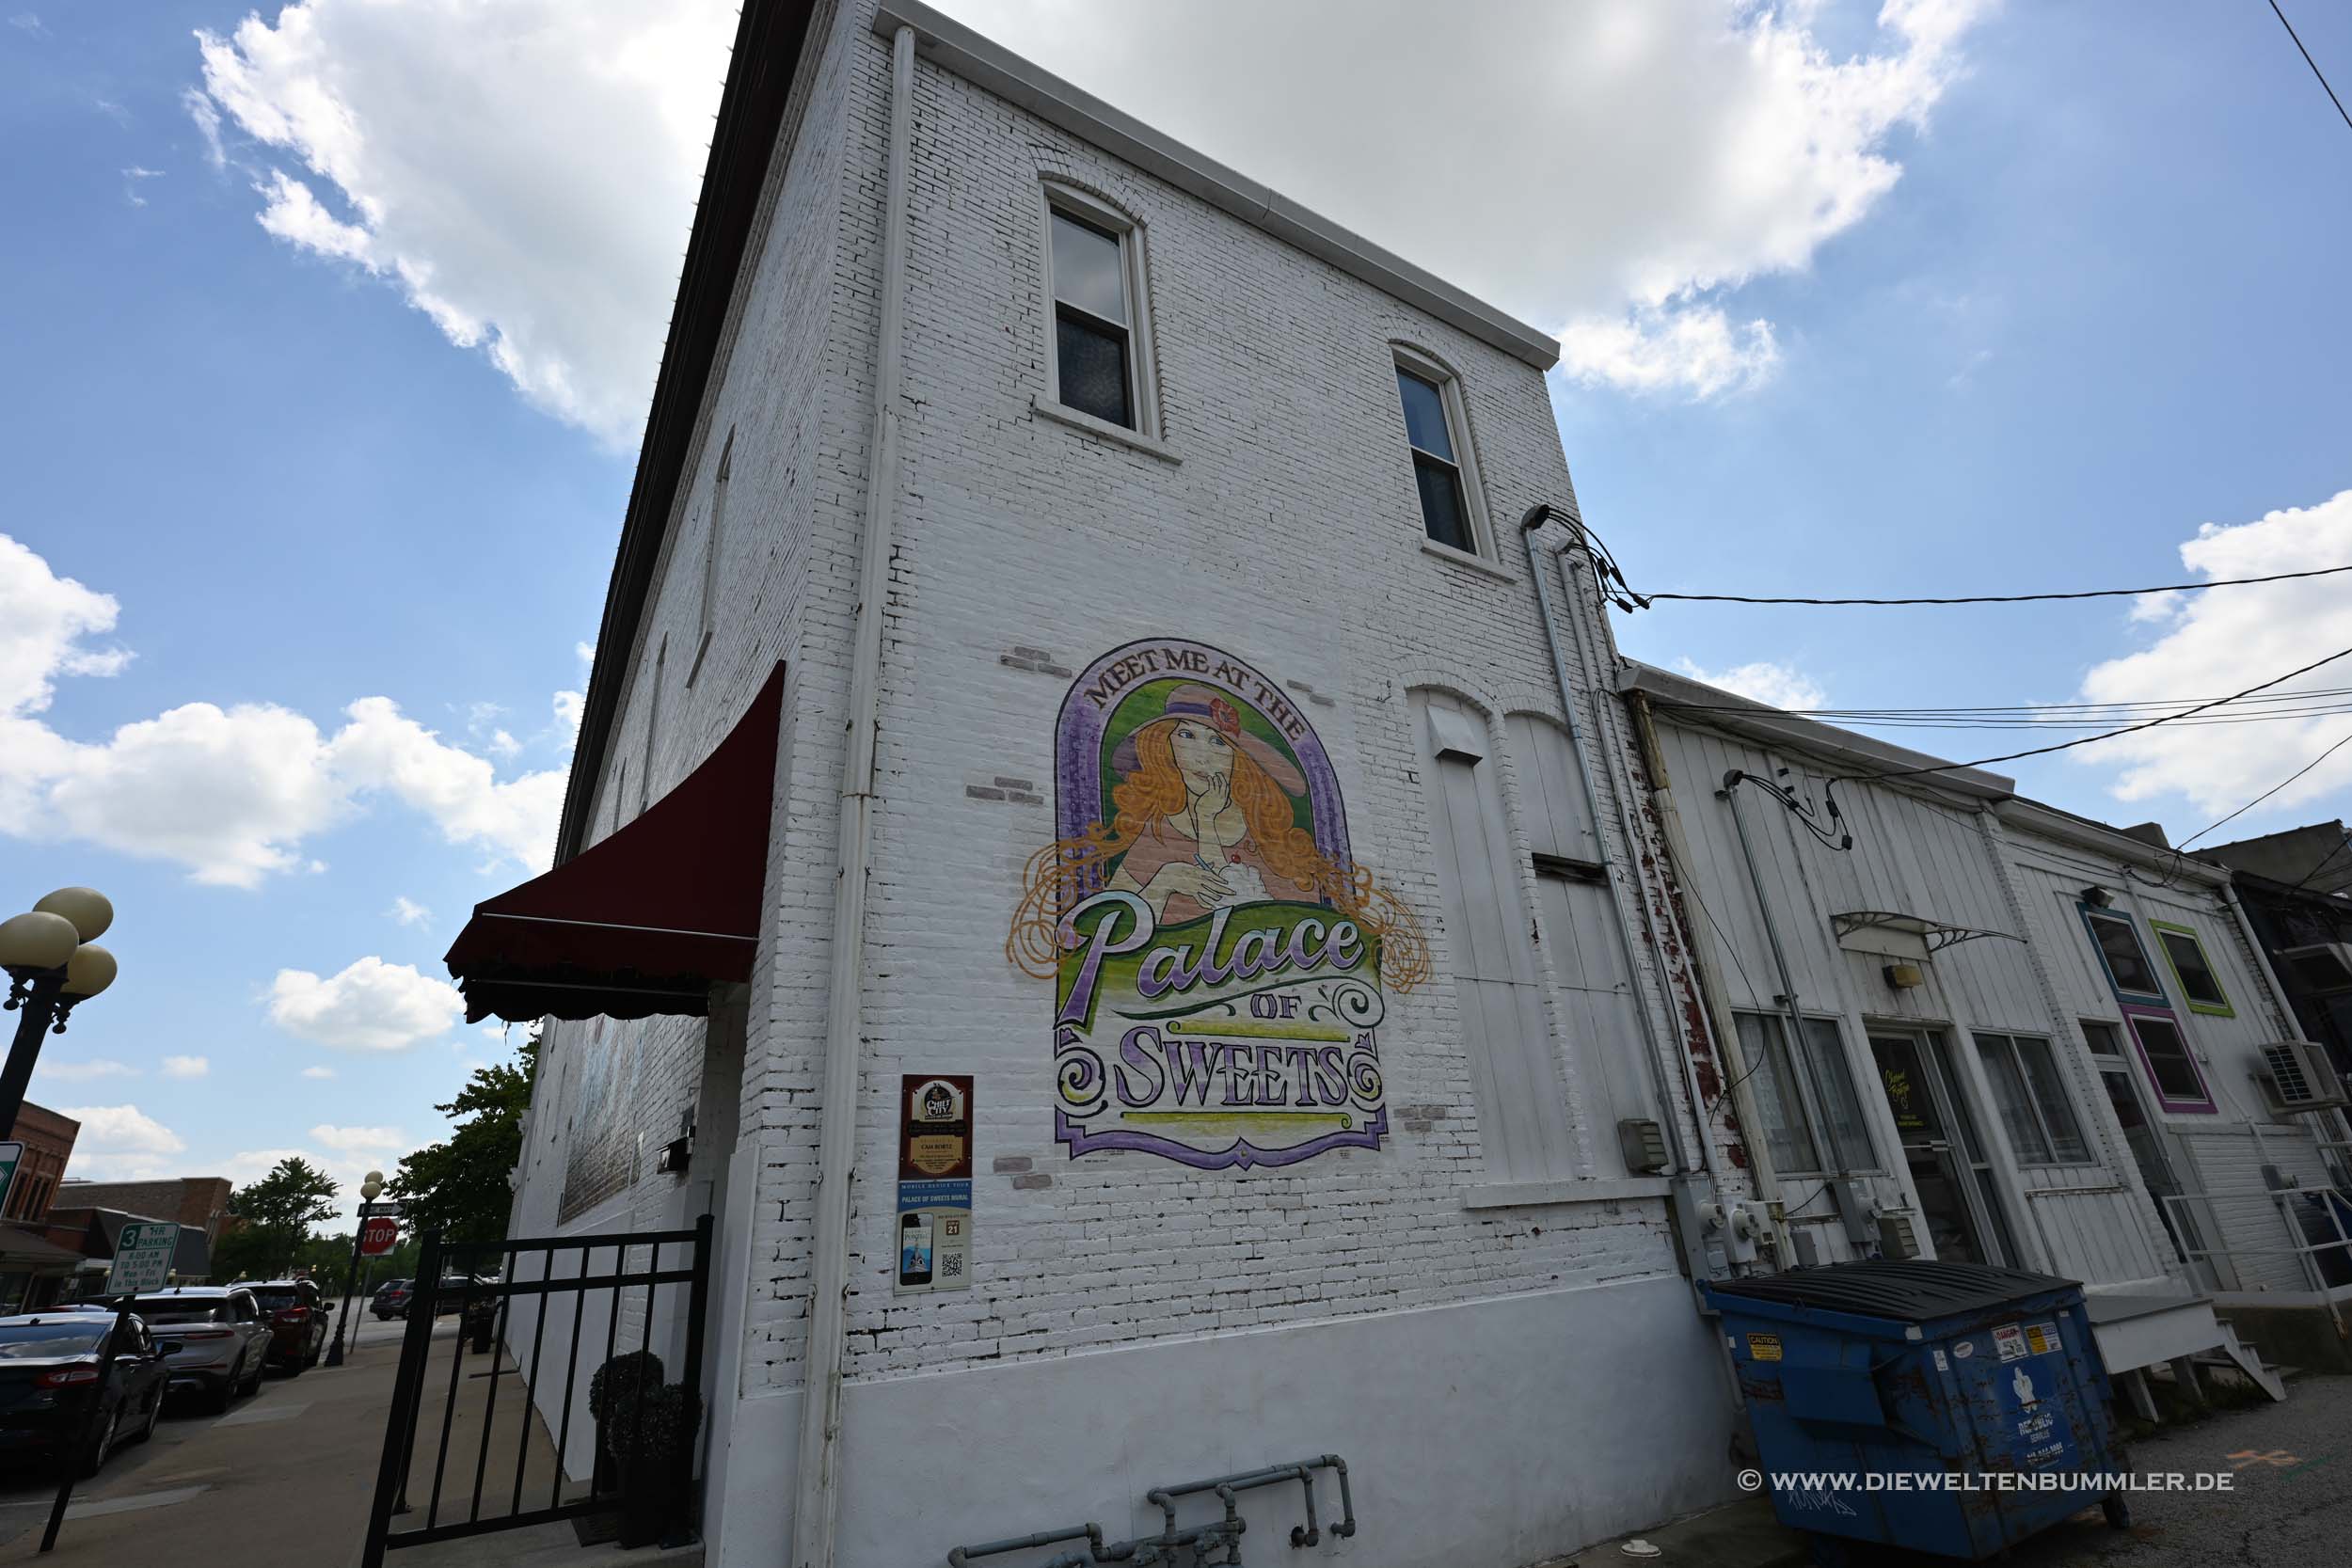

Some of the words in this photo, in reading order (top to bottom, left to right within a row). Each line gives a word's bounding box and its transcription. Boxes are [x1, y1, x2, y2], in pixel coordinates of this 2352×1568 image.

[1084, 649, 1160, 710] MEET
[1163, 648, 1210, 673] ME
[1213, 660, 1250, 691] AT
[1254, 681, 1307, 741] THE
[1054, 890, 1366, 1030] Palace
[1251, 992, 1303, 1020] OF
[1113, 1025, 1351, 1109] SWEETS
[122, 1229, 137, 1247] 3
[947, 1226, 958, 1234] 21
[137, 1237, 173, 1247] PARKING
[1751, 1337, 1778, 1345] CAUTION
